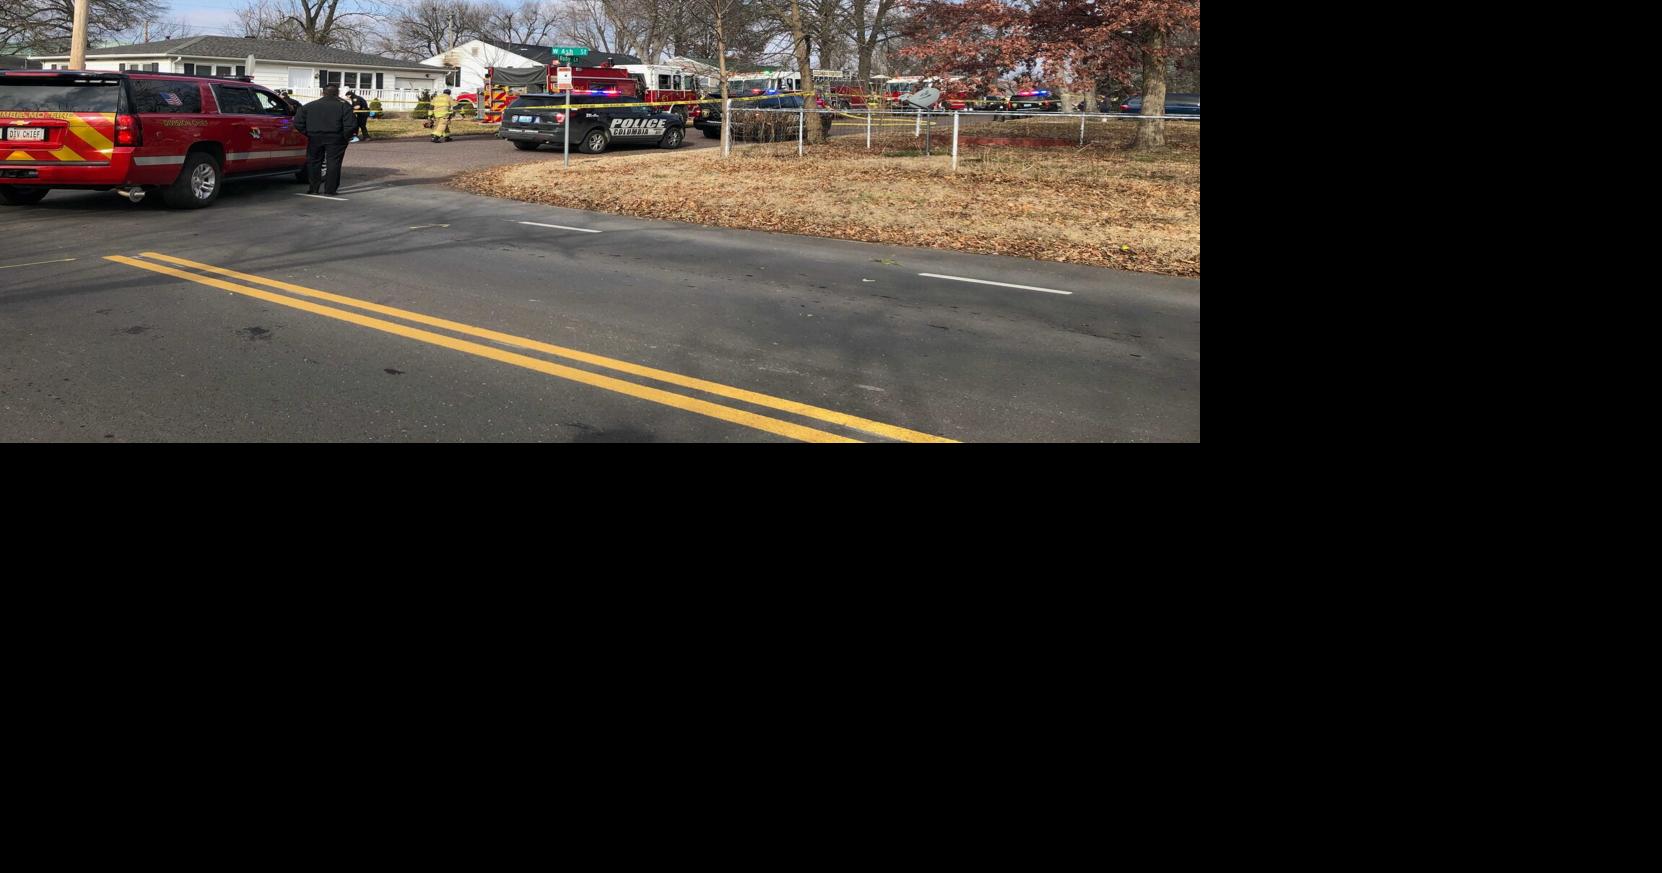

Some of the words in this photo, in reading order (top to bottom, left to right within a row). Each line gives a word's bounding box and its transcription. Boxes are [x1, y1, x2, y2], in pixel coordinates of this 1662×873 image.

[561, 48, 574, 56] Ash
[610, 118, 667, 128] POLICE
[9, 130, 20, 138] DIV
[22, 130, 41, 138] CHIEF
[613, 128, 648, 136] COLUMBIA
